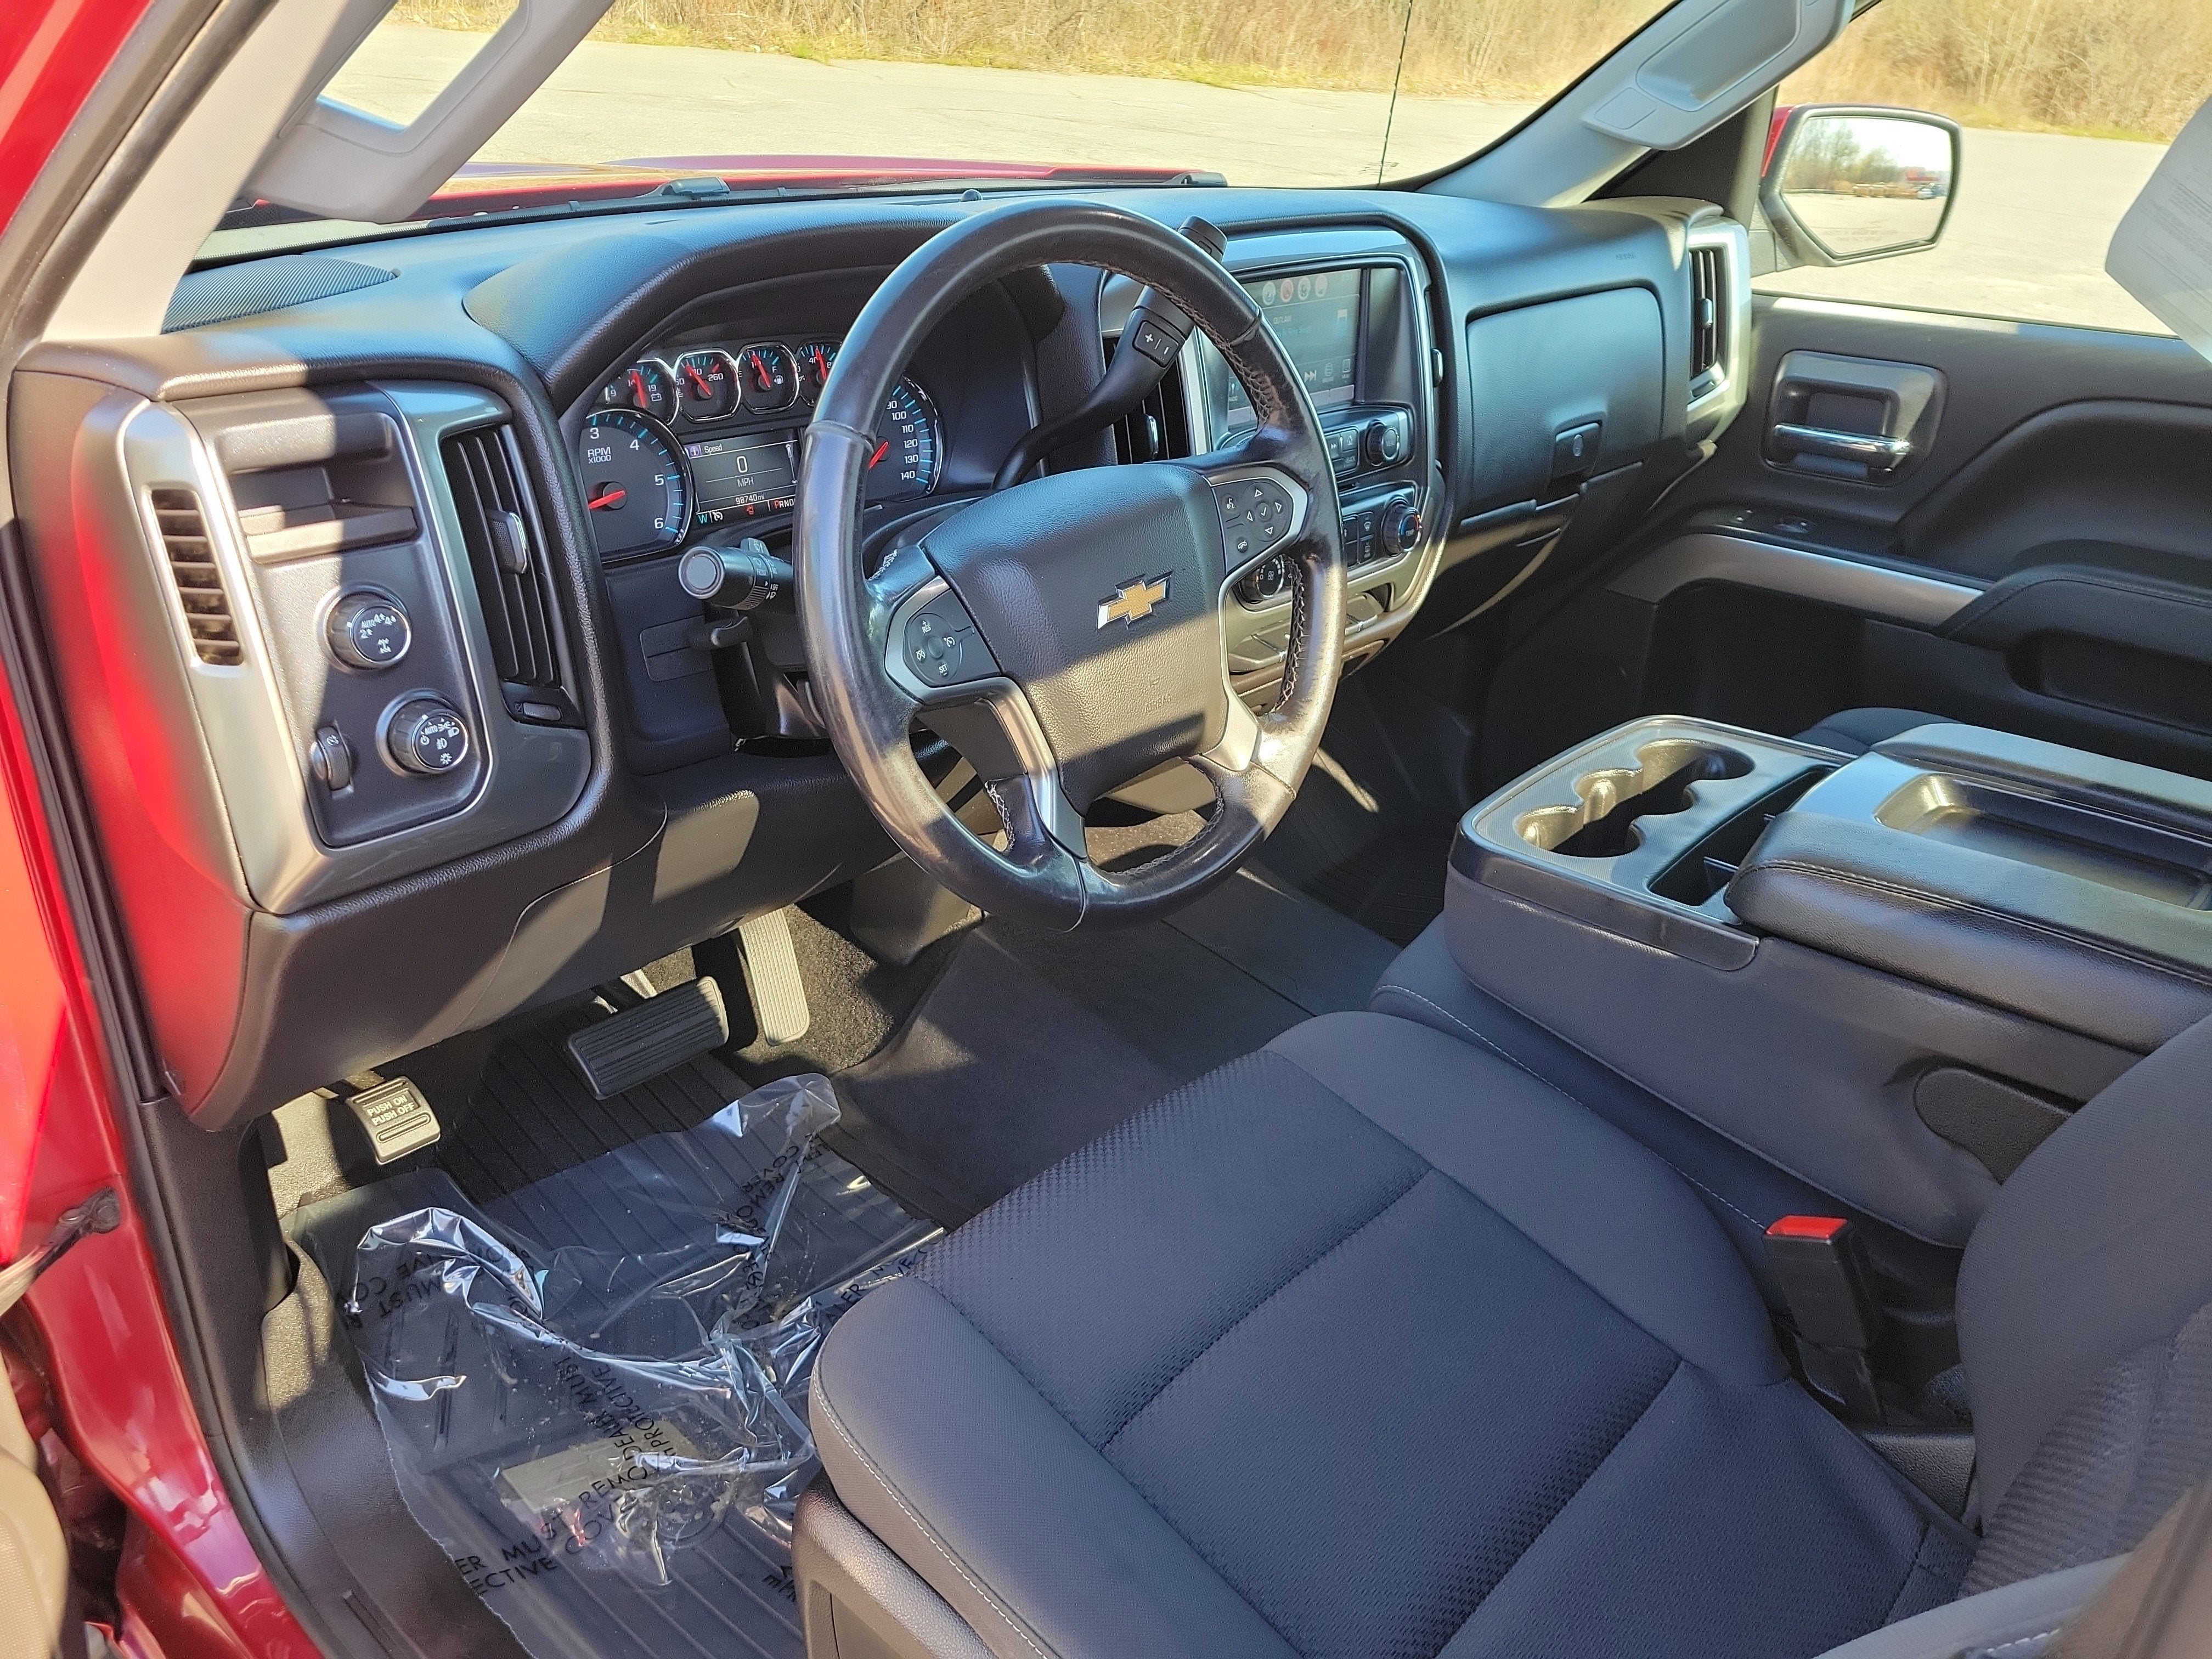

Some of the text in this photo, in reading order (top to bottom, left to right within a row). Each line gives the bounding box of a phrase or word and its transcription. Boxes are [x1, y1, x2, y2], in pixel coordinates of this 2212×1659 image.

[891, 411, 906, 420] 100
[590, 428, 600, 439] 3
[902, 425, 914, 433] 110
[630, 439, 639, 450] 4
[904, 439, 918, 448] 120
[588, 447, 611, 458] RPM
[704, 443, 723, 455] Speed
[905, 454, 918, 464] 130
[737, 456, 748, 473] 0
[654, 474, 664, 486] 5
[900, 471, 915, 481] 140
[737, 477, 754, 488] MPH
[654, 517, 664, 529] 6
[698, 514, 708, 524] W
[361, 619, 376, 629] AUTO
[922, 624, 932, 634] RES
[939, 663, 947, 673] SET
[425, 725, 438, 735] AUTO
[367, 1094, 408, 1116] PUSH ON
[371, 1102, 415, 1126] PUSH OFF
